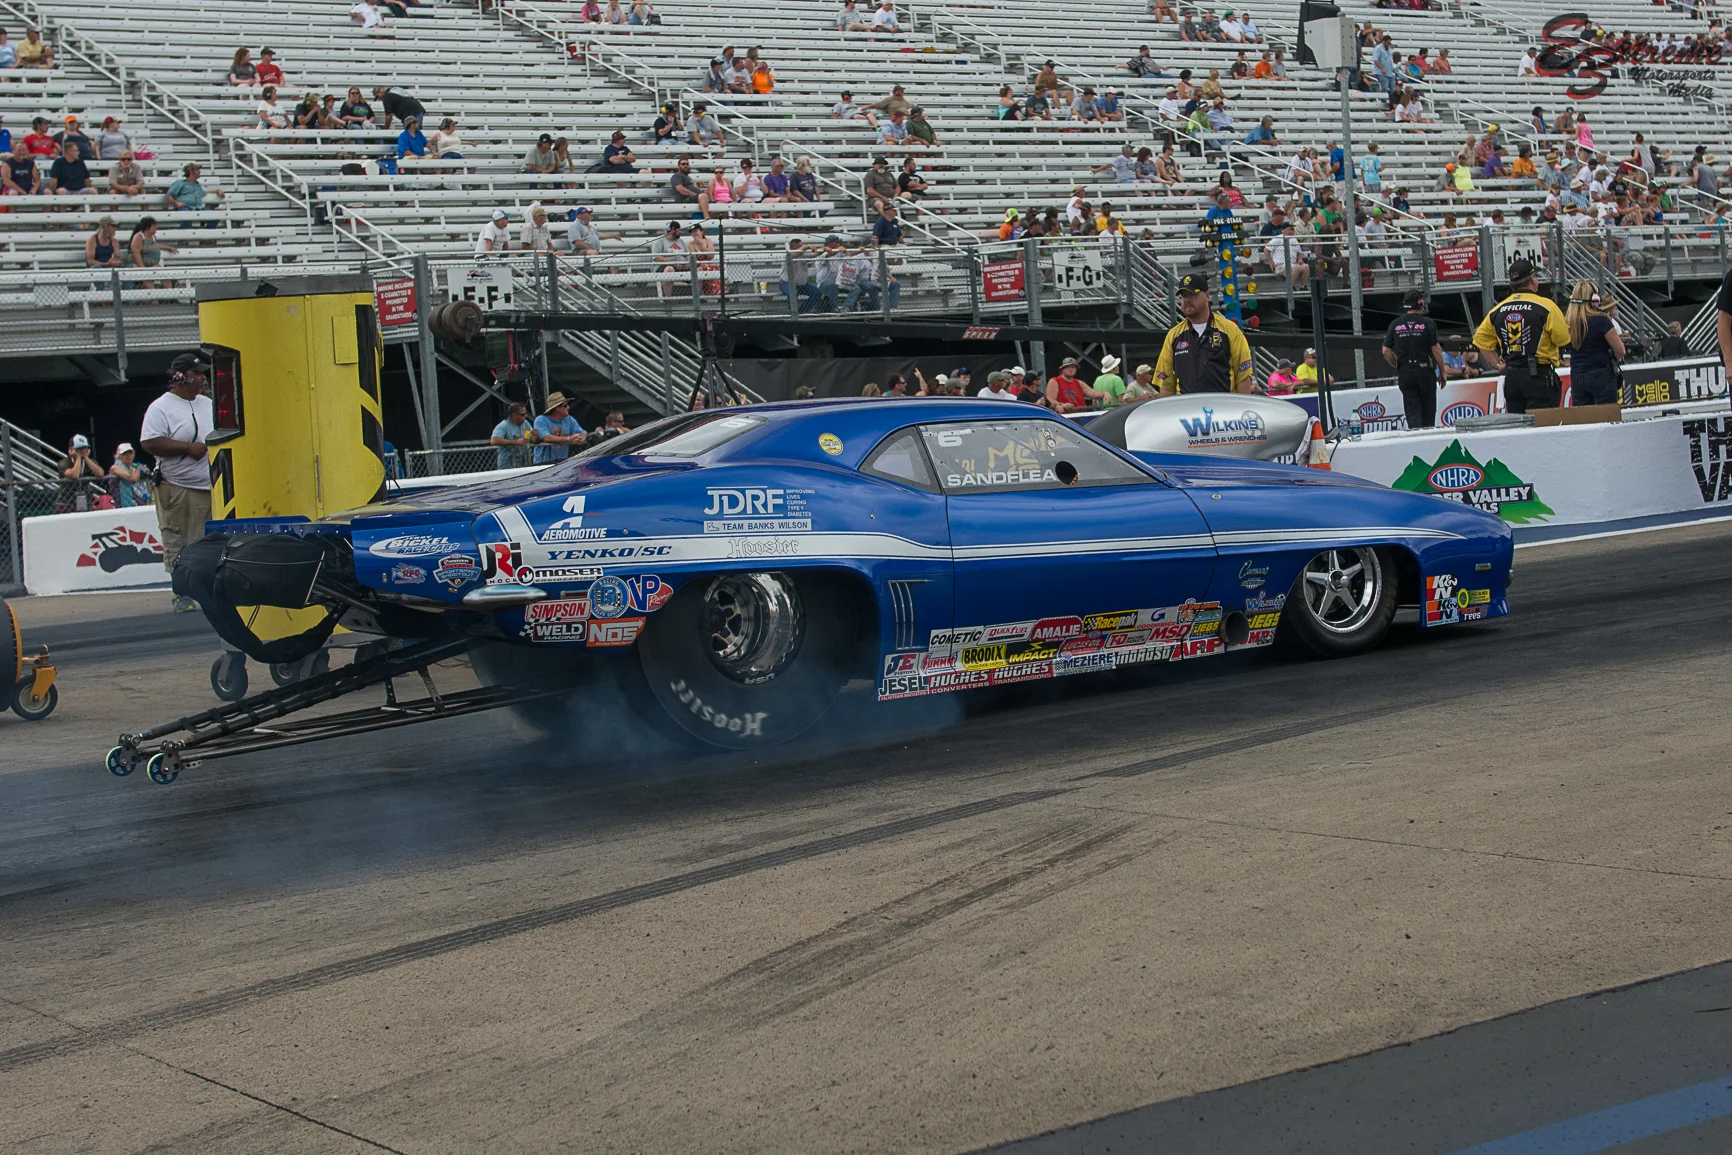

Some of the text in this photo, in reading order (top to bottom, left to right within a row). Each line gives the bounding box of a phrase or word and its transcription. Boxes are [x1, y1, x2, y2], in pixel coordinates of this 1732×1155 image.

[1500, 304, 1533, 313] OFFICIAL
[1635, 380, 1669, 395] Mello
[1674, 366, 1729, 398] THU
[1361, 406, 1382, 419] NHRA
[1180, 406, 1259, 438] WILKINS
[937, 430, 963, 448] 6
[1188, 437, 1220, 445] WHEELS
[1228, 434, 1267, 442] WRENCHES
[947, 469, 1057, 487] SANDFLEA
[1436, 468, 1477, 488] NHRA
[703, 489, 784, 515] JDRF
[1468, 486, 1531, 504] VALLEY
[540, 527, 607, 541] AEROMOTIVE
[722, 521, 808, 531] TEAM BANKS WILSON
[390, 537, 449, 547] BICKEL
[426, 543, 460, 553] CARS
[727, 536, 799, 558] Hoosier
[547, 545, 672, 561] YENKO/SC
[534, 567, 602, 577] MOSER
[627, 575, 661, 611] VP
[530, 602, 587, 619] SIMPSON
[1094, 613, 1137, 630] Racepak
[1136, 621, 1176, 629] GOODRIDGE
[1193, 621, 1220, 633] JEGS
[1249, 612, 1281, 629] JEGS
[536, 624, 583, 636] WELD
[589, 620, 641, 643] NOS
[931, 630, 983, 646] COMETIC
[1032, 624, 1081, 639] AMALIE
[1149, 624, 1191, 640] MSD
[1064, 640, 1088, 650] LUCAS
[1089, 639, 1100, 647] OIL
[1172, 638, 1223, 659] ARP
[964, 644, 1004, 665] BRODIX
[1009, 648, 1057, 663] IMPACT
[1064, 652, 1114, 669] MEZIERE
[744, 672, 775, 685] USA
[929, 669, 990, 688] HUGHES
[993, 661, 1050, 680] HUGHES
[879, 676, 928, 696] JESEL
[994, 673, 1051, 685] TRANSMISSIONS
[931, 682, 990, 694] CONVERTERS
[670, 679, 769, 738] Hoosier
